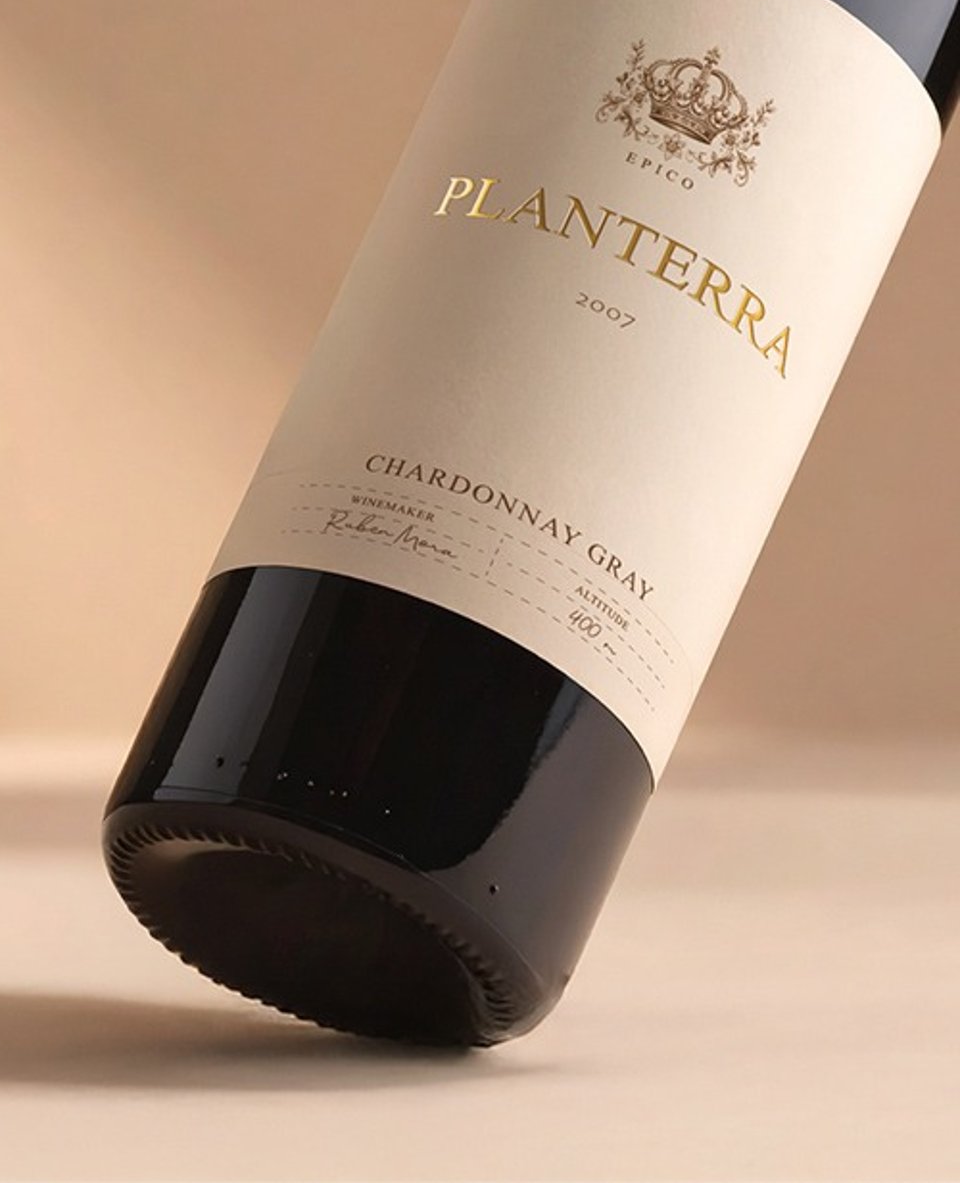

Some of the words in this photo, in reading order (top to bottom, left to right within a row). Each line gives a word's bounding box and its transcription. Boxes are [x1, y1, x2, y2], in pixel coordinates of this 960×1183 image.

[625, 151, 694, 190] EPICO
[434, 176, 791, 379] PLANTERRA
[575, 292, 636, 328] 2007
[351, 495, 435, 522] WINEMAKER
[365, 454, 582, 546] CHARDONNAY
[587, 543, 654, 601] GRAY
[568, 610, 602, 638] 400
[574, 585, 629, 631] ALTITUDE
